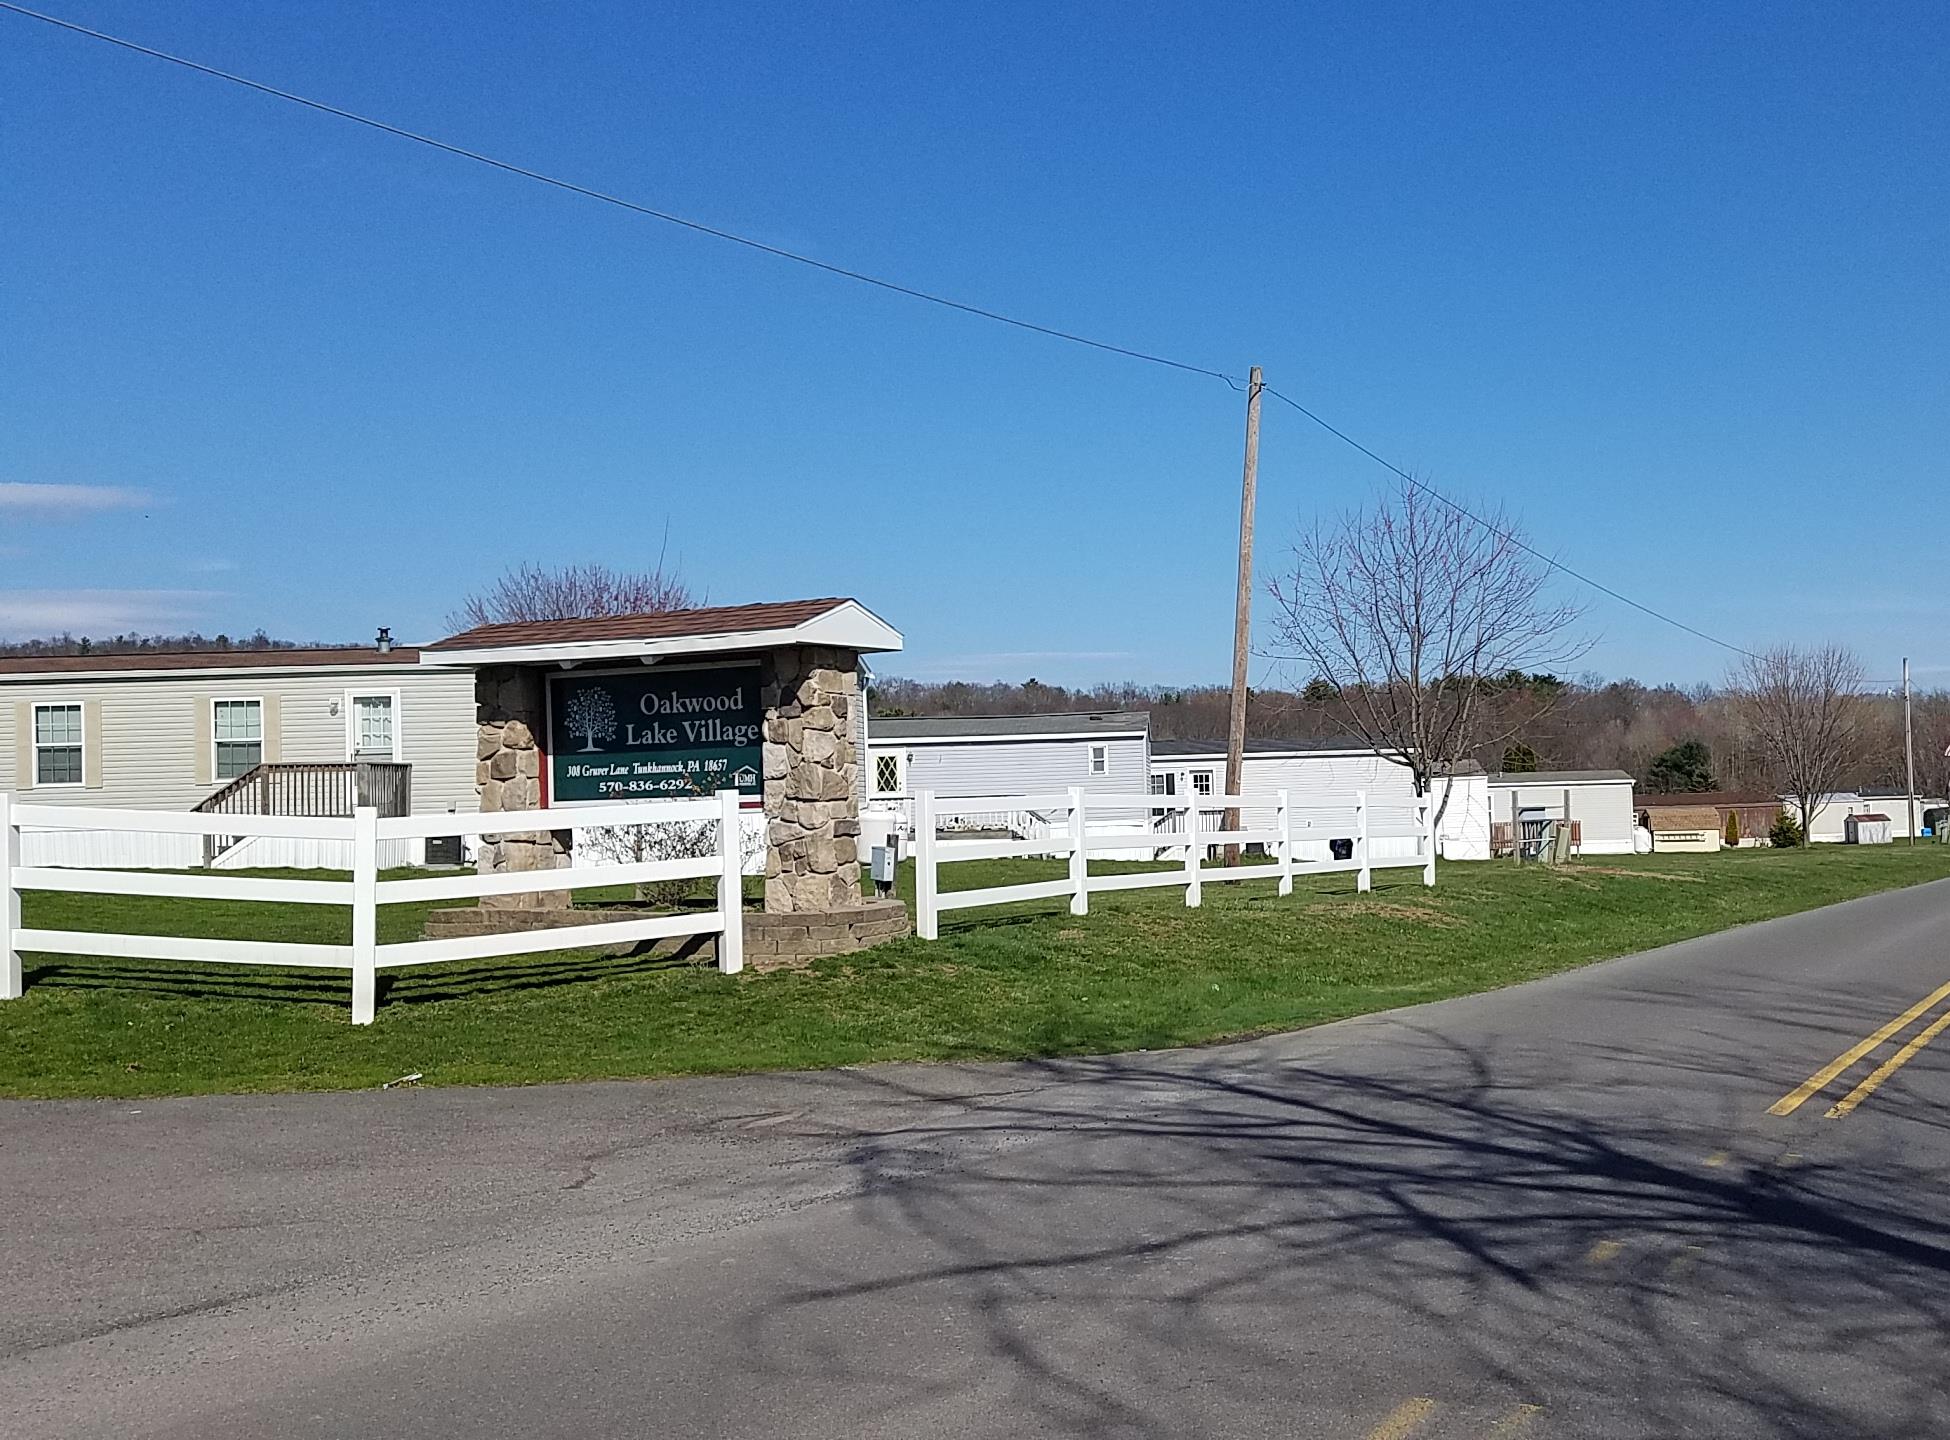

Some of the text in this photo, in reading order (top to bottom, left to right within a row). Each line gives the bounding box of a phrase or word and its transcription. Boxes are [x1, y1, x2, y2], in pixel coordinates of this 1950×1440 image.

[640, 687, 743, 715] Oakwood
[625, 719, 759, 746] Lake Village
[567, 765, 581, 777] 308
[610, 763, 629, 775] Lane
[687, 760, 700, 772] PA
[704, 759, 728, 771] 18657
[599, 779, 692, 792] 570-836-6292
